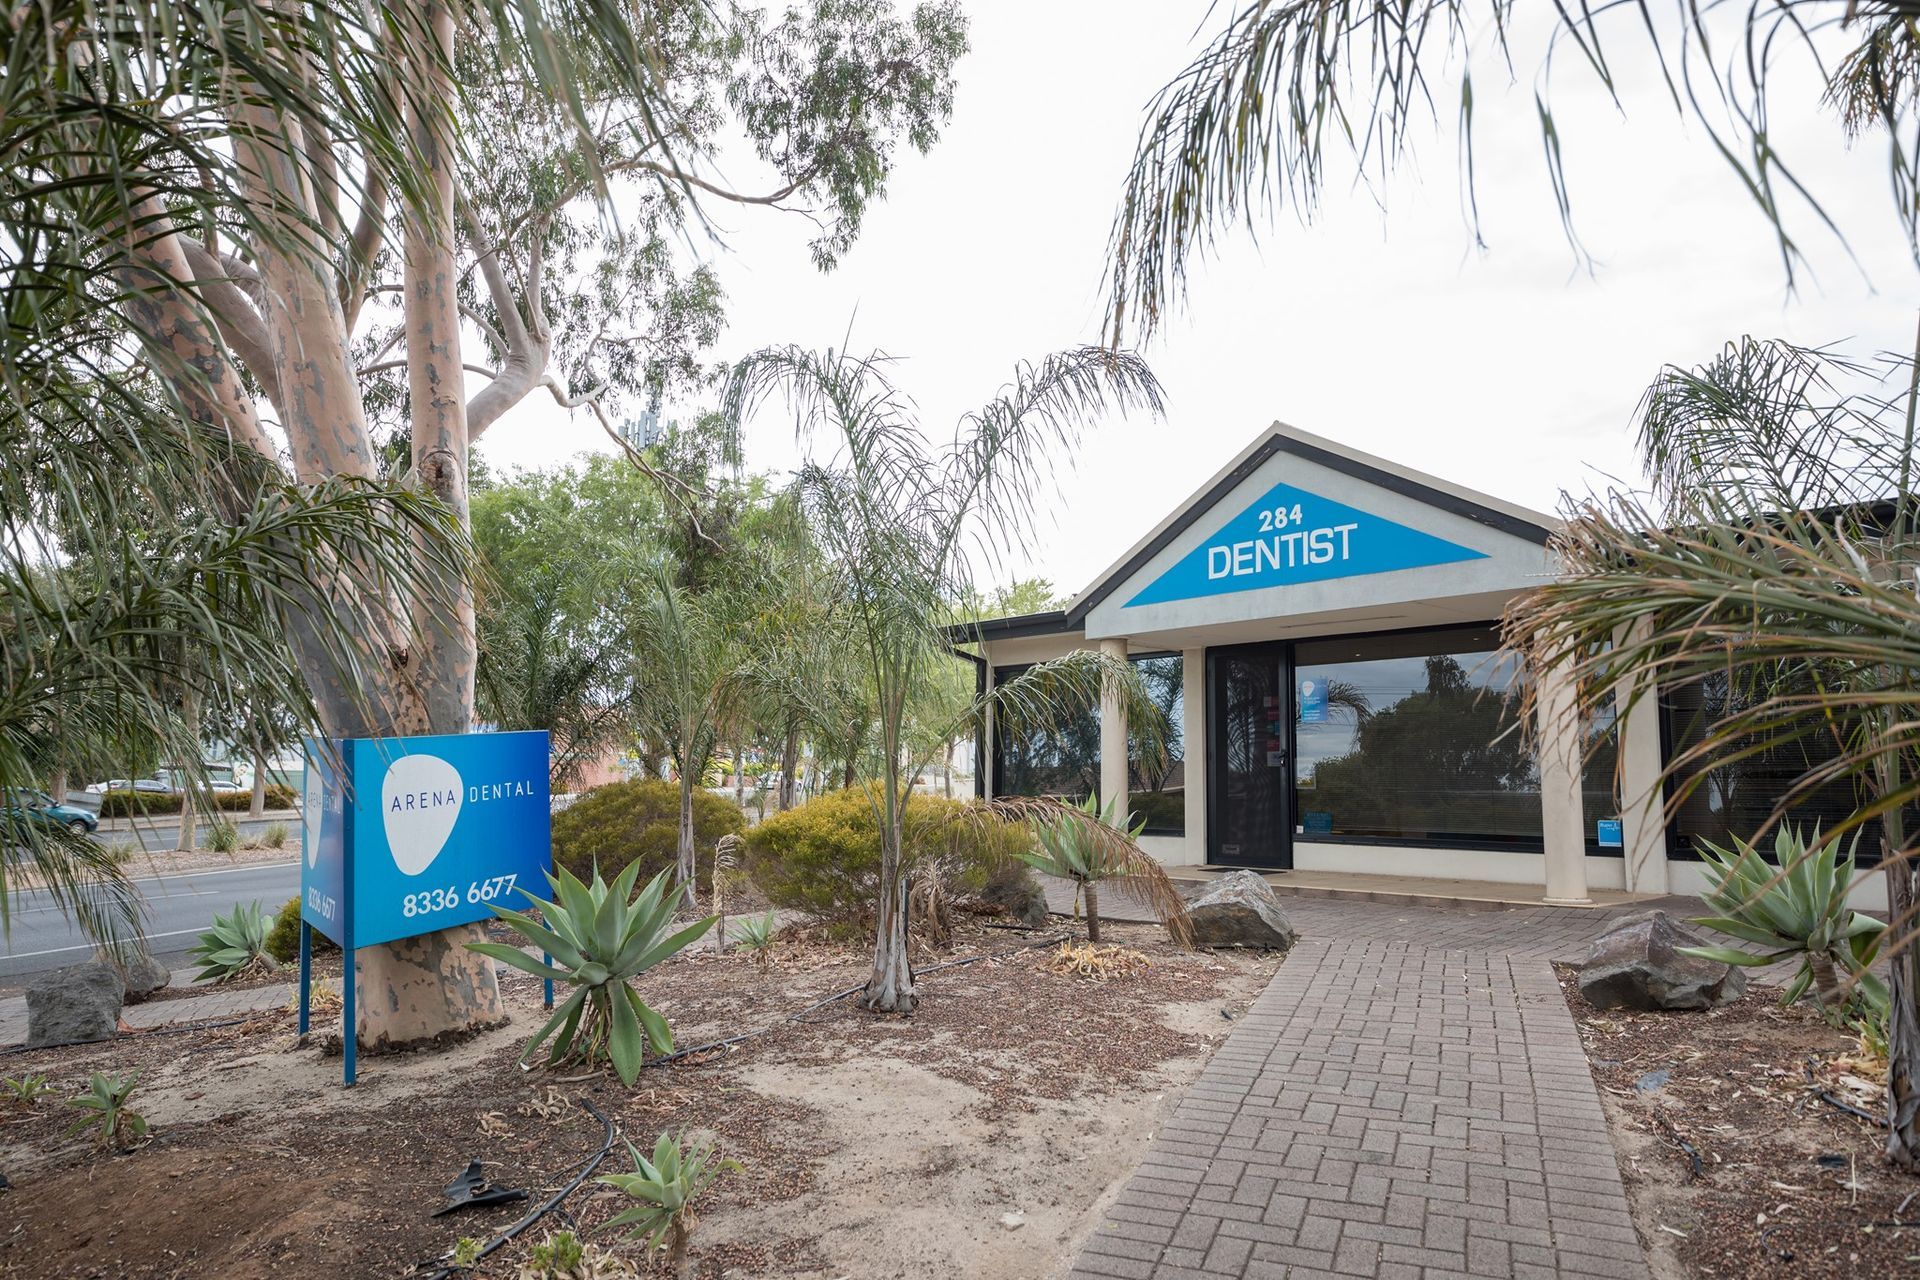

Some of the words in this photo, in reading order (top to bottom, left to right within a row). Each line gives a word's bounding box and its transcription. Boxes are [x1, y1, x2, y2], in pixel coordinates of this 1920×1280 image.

[1258, 503, 1303, 533] 284
[1208, 523, 1358, 580] DENTIST
[391, 789, 456, 812] ARENA
[469, 780, 535, 803] DENTAL
[402, 885, 460, 918] 8336
[466, 873, 518, 904] 6677
